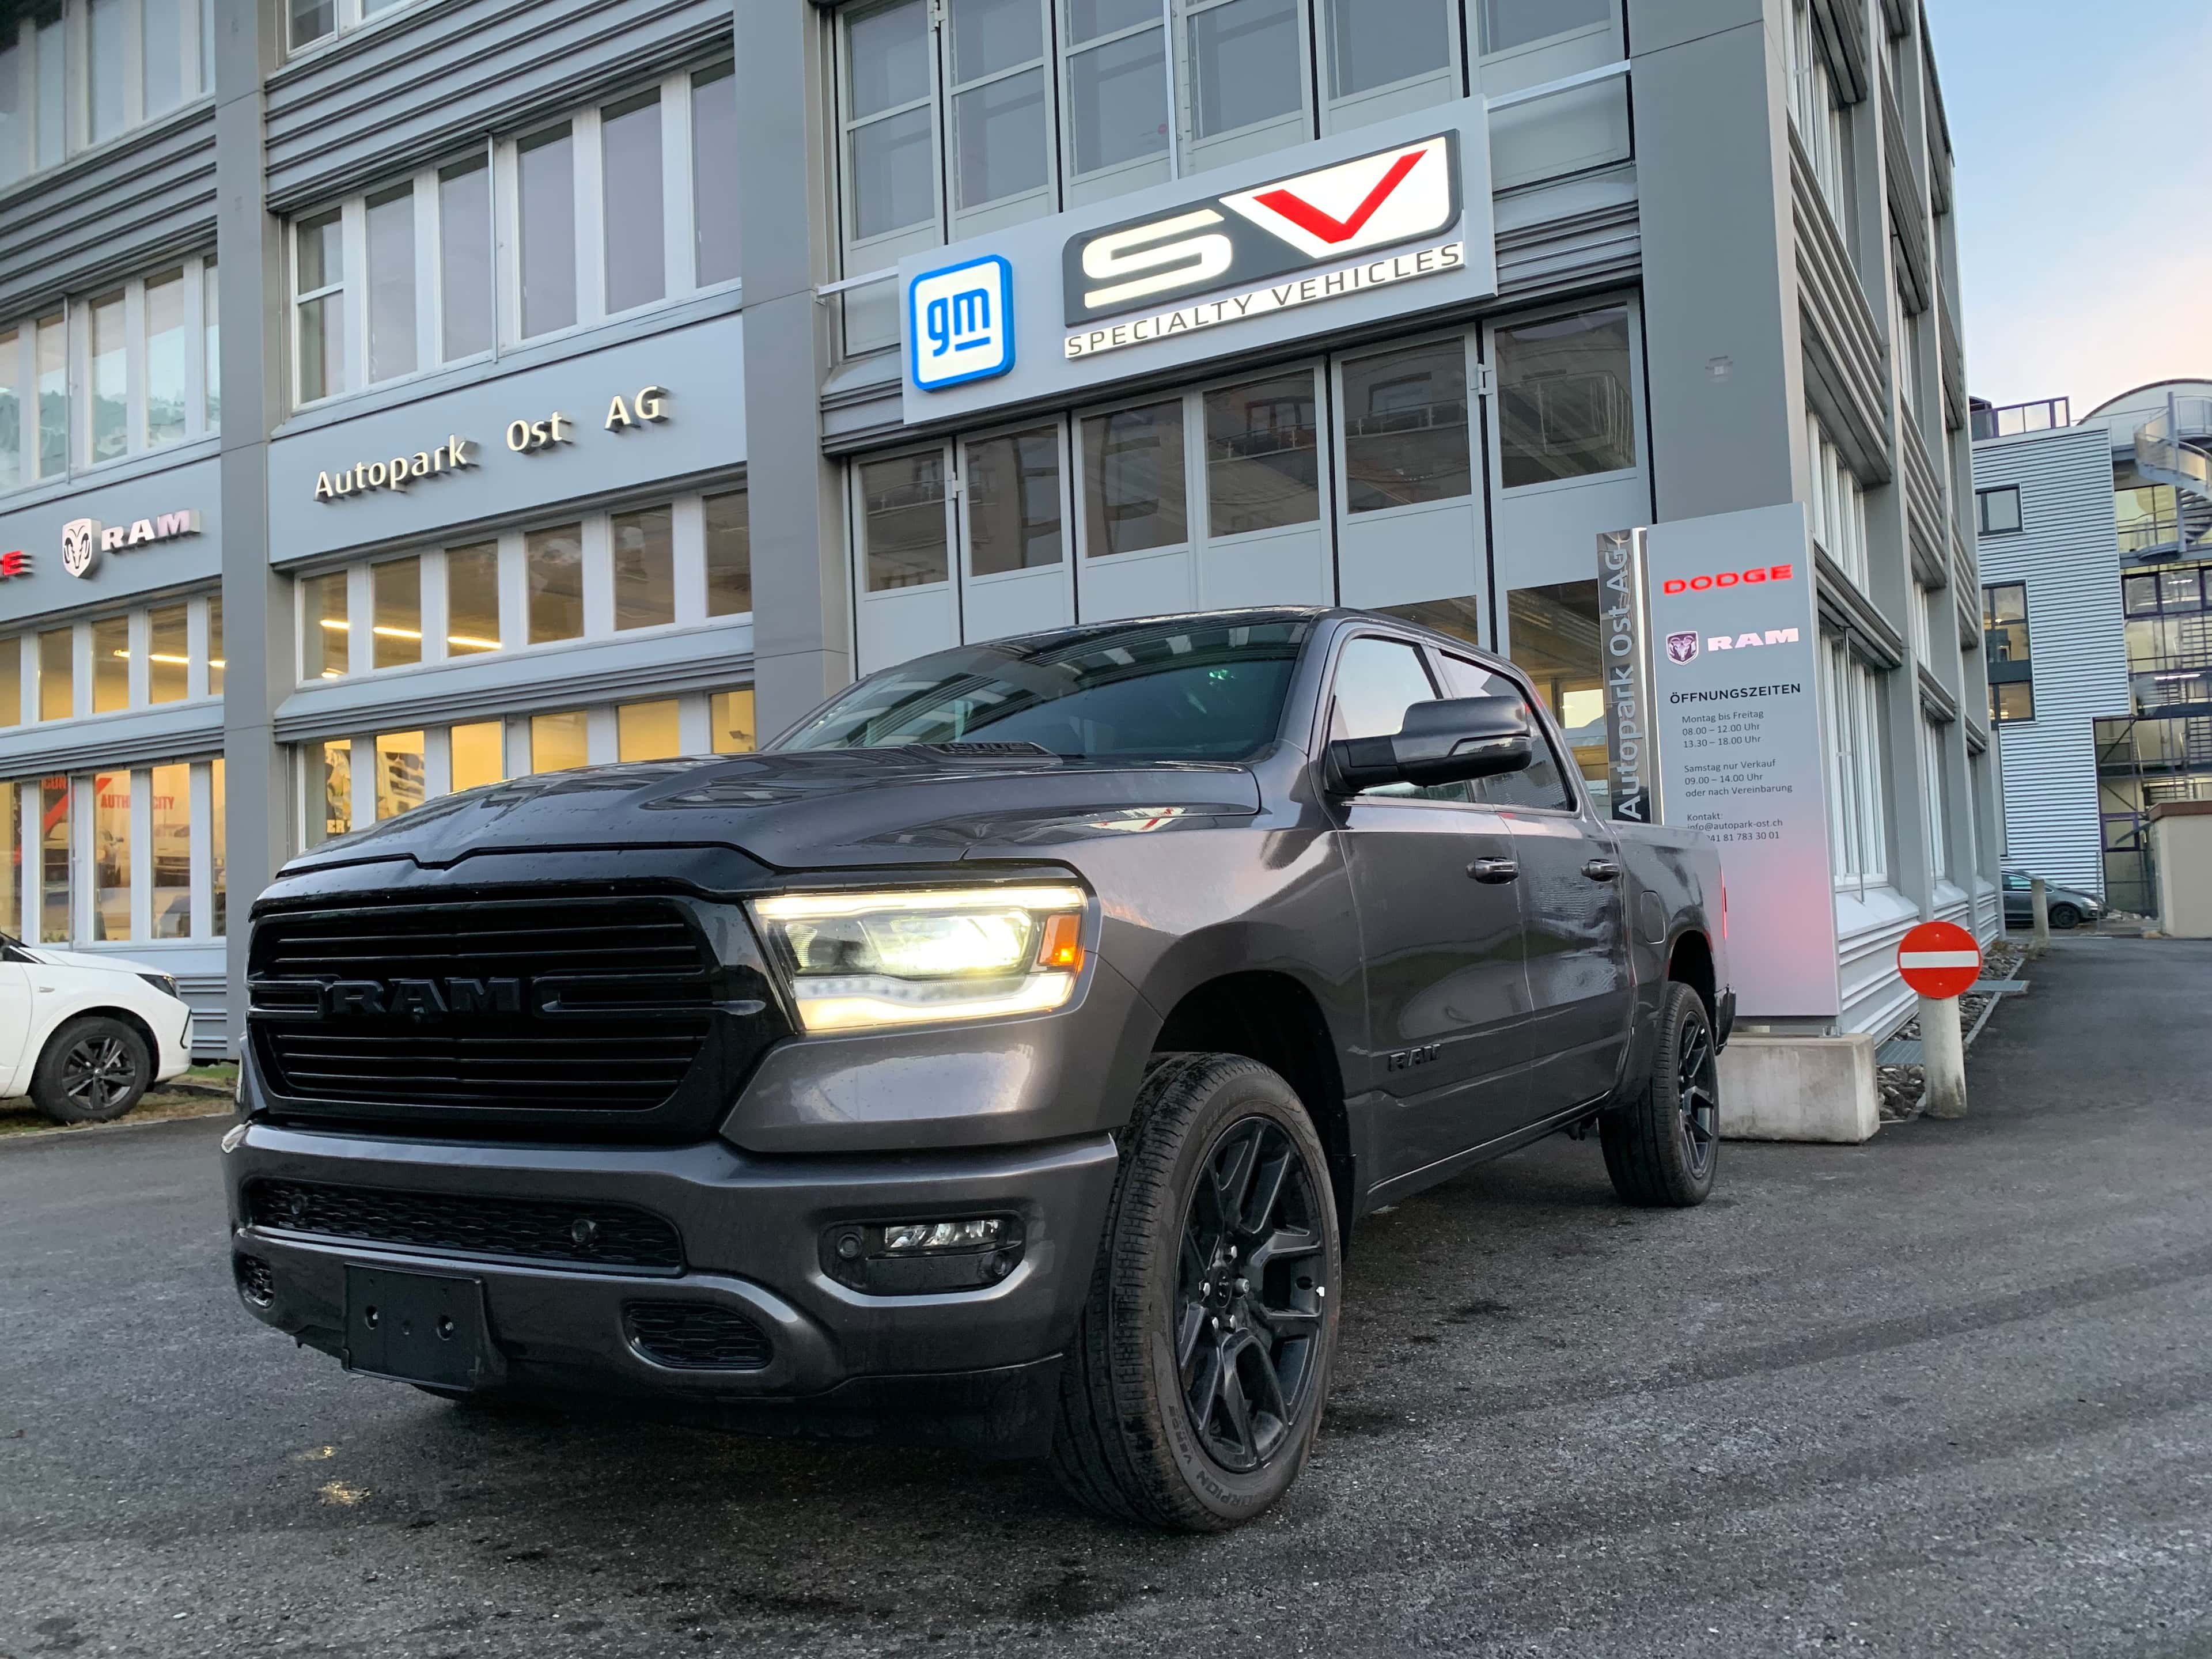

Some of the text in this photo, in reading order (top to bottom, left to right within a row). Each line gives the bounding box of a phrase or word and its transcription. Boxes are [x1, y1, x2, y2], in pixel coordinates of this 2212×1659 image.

[1083, 147, 1429, 309] SV
[1067, 243, 1460, 356] SPECIALTY VEHICLES
[926, 287, 991, 358] gm
[314, 385, 662, 500] Autopark Ost AG
[101, 509, 195, 551] RAM
[0, 550, 24, 575] E
[1664, 564, 1793, 596] DODGE
[1707, 628, 1799, 651] RAM
[1605, 549, 1643, 820] Autopark Ost AG
[1670, 683, 1801, 704] ÖFFNUNGSZEITEN
[1682, 715, 1716, 723] Montag
[1733, 711, 1764, 719] Freitag
[1682, 727, 1707, 736] 08.00
[1718, 724, 1741, 733] 12.00
[1744, 722, 1760, 730] Uhr
[1684, 739, 1707, 748] 13.30
[1718, 736, 1742, 745] 18.00
[1745, 735, 1761, 743] Uhr
[1684, 764, 1721, 772] Samstag
[1741, 759, 1776, 768] Verkauf
[1685, 777, 1709, 785] 09.00
[1719, 774, 1744, 783] 14.00
[1747, 772, 1763, 781] Uhr
[101, 794, 175, 809] AUTHCITY
[1685, 785, 1793, 797] oder nach Vereinbarung
[1687, 812, 1723, 821] Kontakt:
[1755, 832, 1766, 840] 30
[333, 978, 521, 1014] RAM
